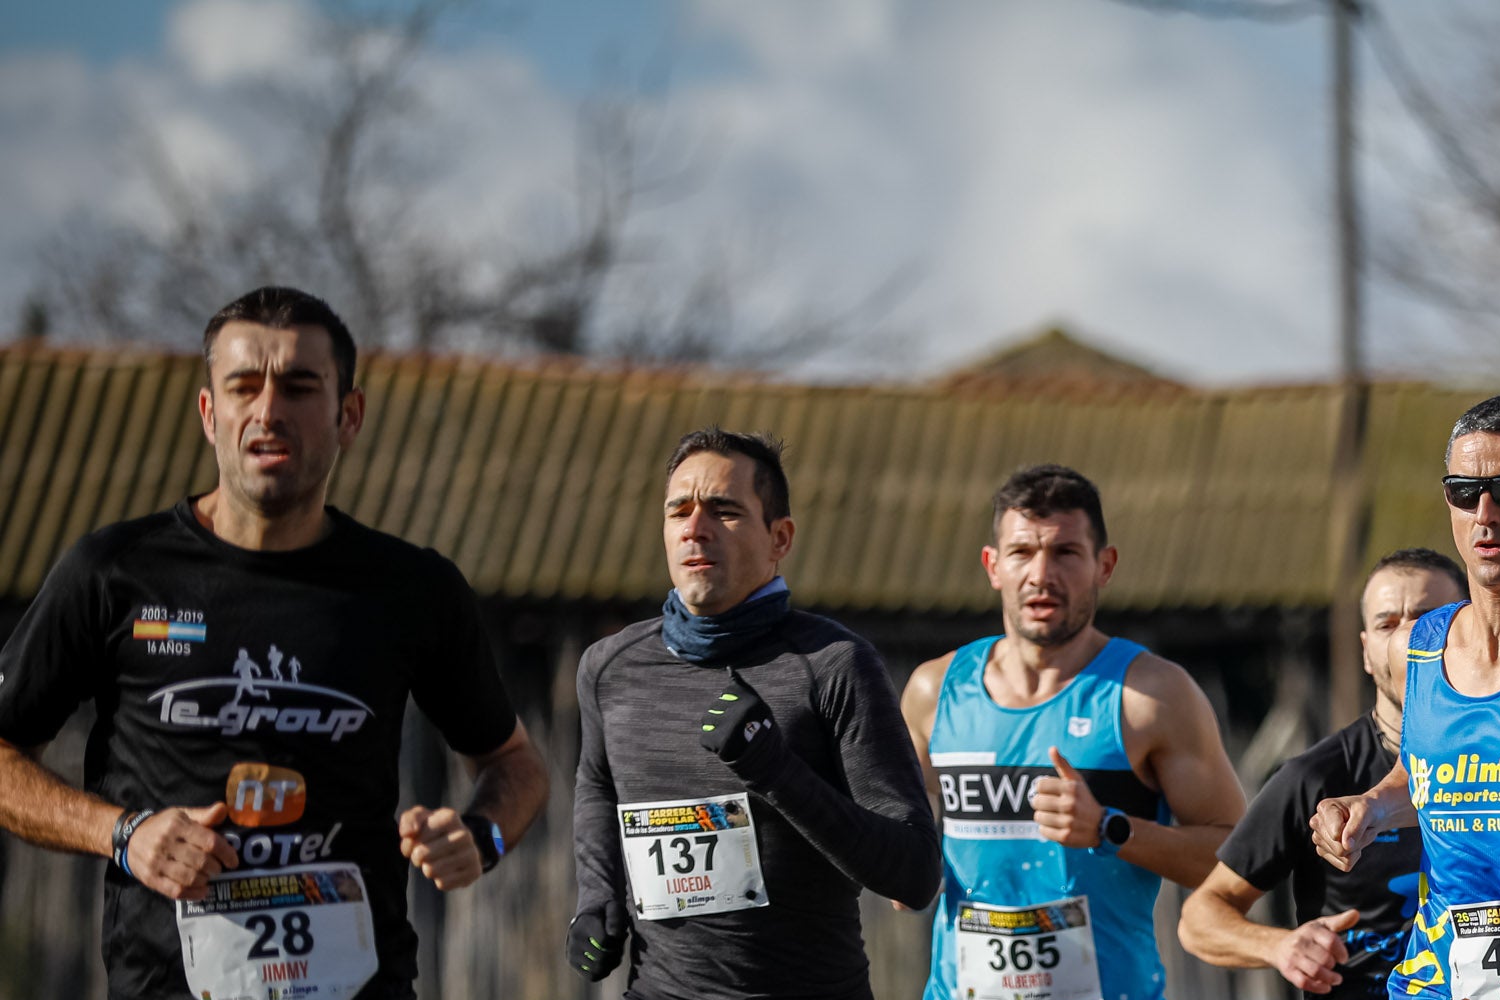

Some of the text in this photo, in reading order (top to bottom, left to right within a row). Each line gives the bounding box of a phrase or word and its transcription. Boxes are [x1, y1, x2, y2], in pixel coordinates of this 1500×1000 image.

[141, 605, 168, 621] 2003
[176, 609, 204, 624] 2019
[146, 639, 191, 657] 16 AÑOS
[648, 807, 695, 818] CARRERA
[649, 816, 695, 826] POPULAR
[1429, 818, 1469, 832] TRAIL
[1472, 818, 1484, 832] &
[648, 834, 718, 876] 137
[231, 875, 299, 890] CARRERA
[666, 875, 712, 895] I.UCEDA
[232, 885, 299, 900] POPULAR
[229, 899, 270, 908] Secaderos
[1456, 911, 1470, 923] 26
[244, 911, 314, 960] 28
[1460, 926, 1472, 934] Ruta
[988, 935, 1060, 971] 365
[261, 961, 308, 983] JIMMY
[1002, 972, 1053, 989] ALBERTO
